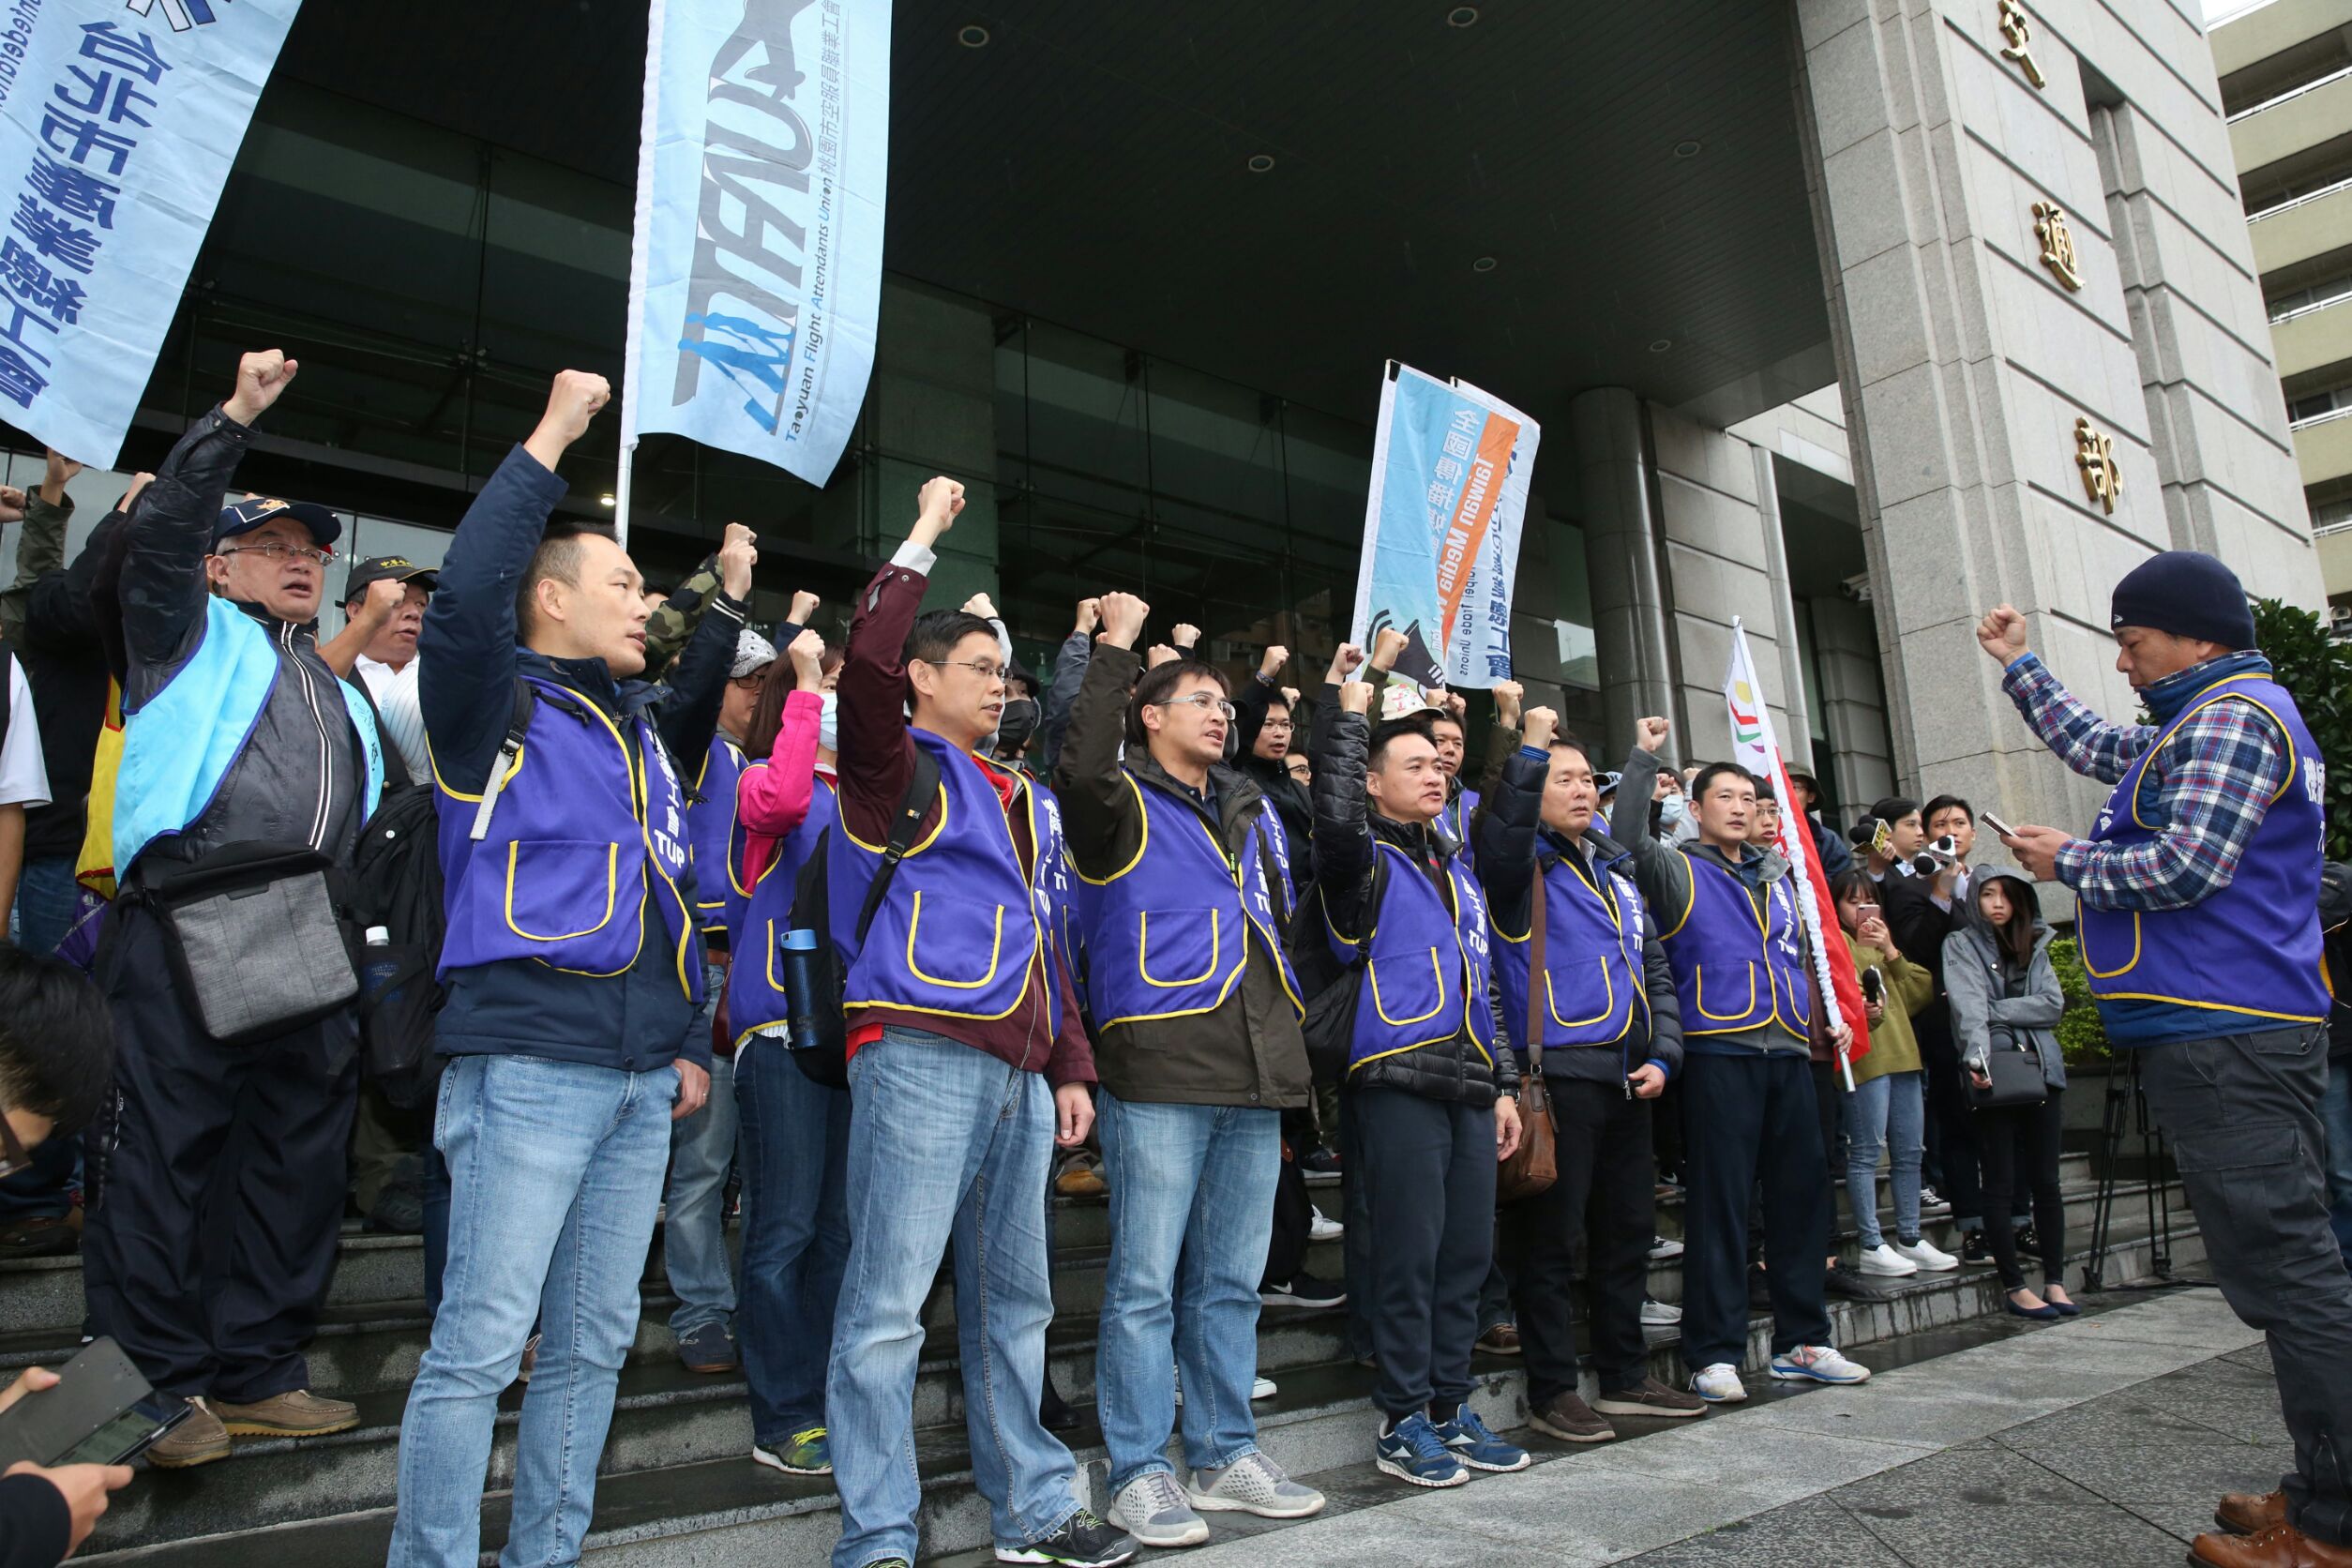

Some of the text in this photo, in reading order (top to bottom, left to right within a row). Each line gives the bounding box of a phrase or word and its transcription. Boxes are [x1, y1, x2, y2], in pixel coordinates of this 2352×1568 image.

[817, 0, 841, 177] 桃園市空服員職業工會
[785, 176, 833, 442] Taoyuan Flight Attendants Union
[654, 829, 685, 868] TUP
[1469, 929, 1488, 957] TUP
